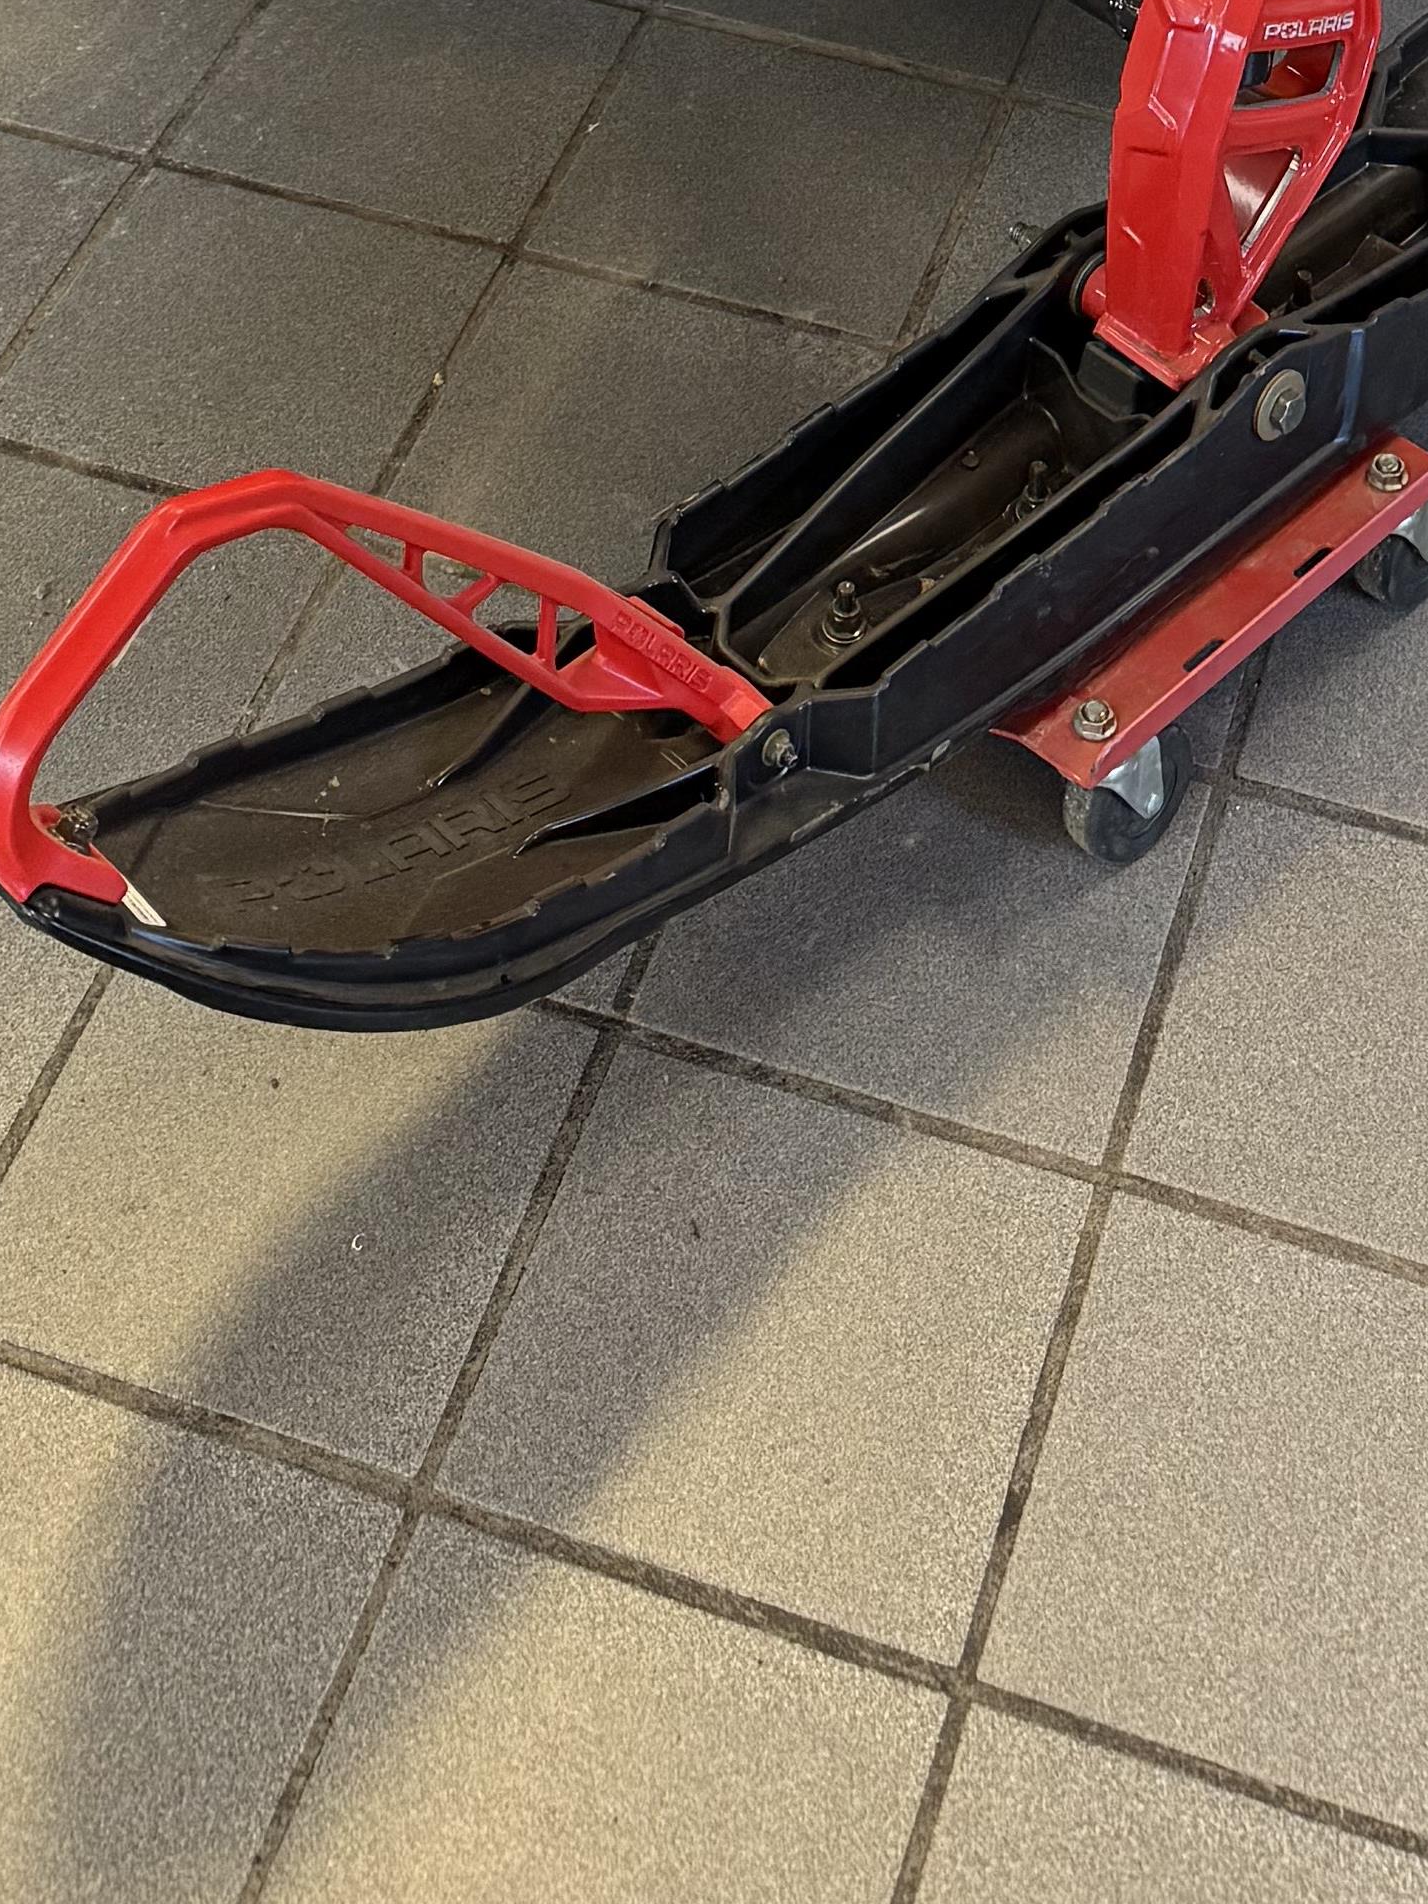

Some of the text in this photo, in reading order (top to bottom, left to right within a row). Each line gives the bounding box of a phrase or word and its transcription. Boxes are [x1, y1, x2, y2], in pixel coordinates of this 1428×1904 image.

[1263, 11, 1355, 42] POLARIS
[612, 610, 713, 693] POLARIS
[224, 774, 572, 914] POLARIS
